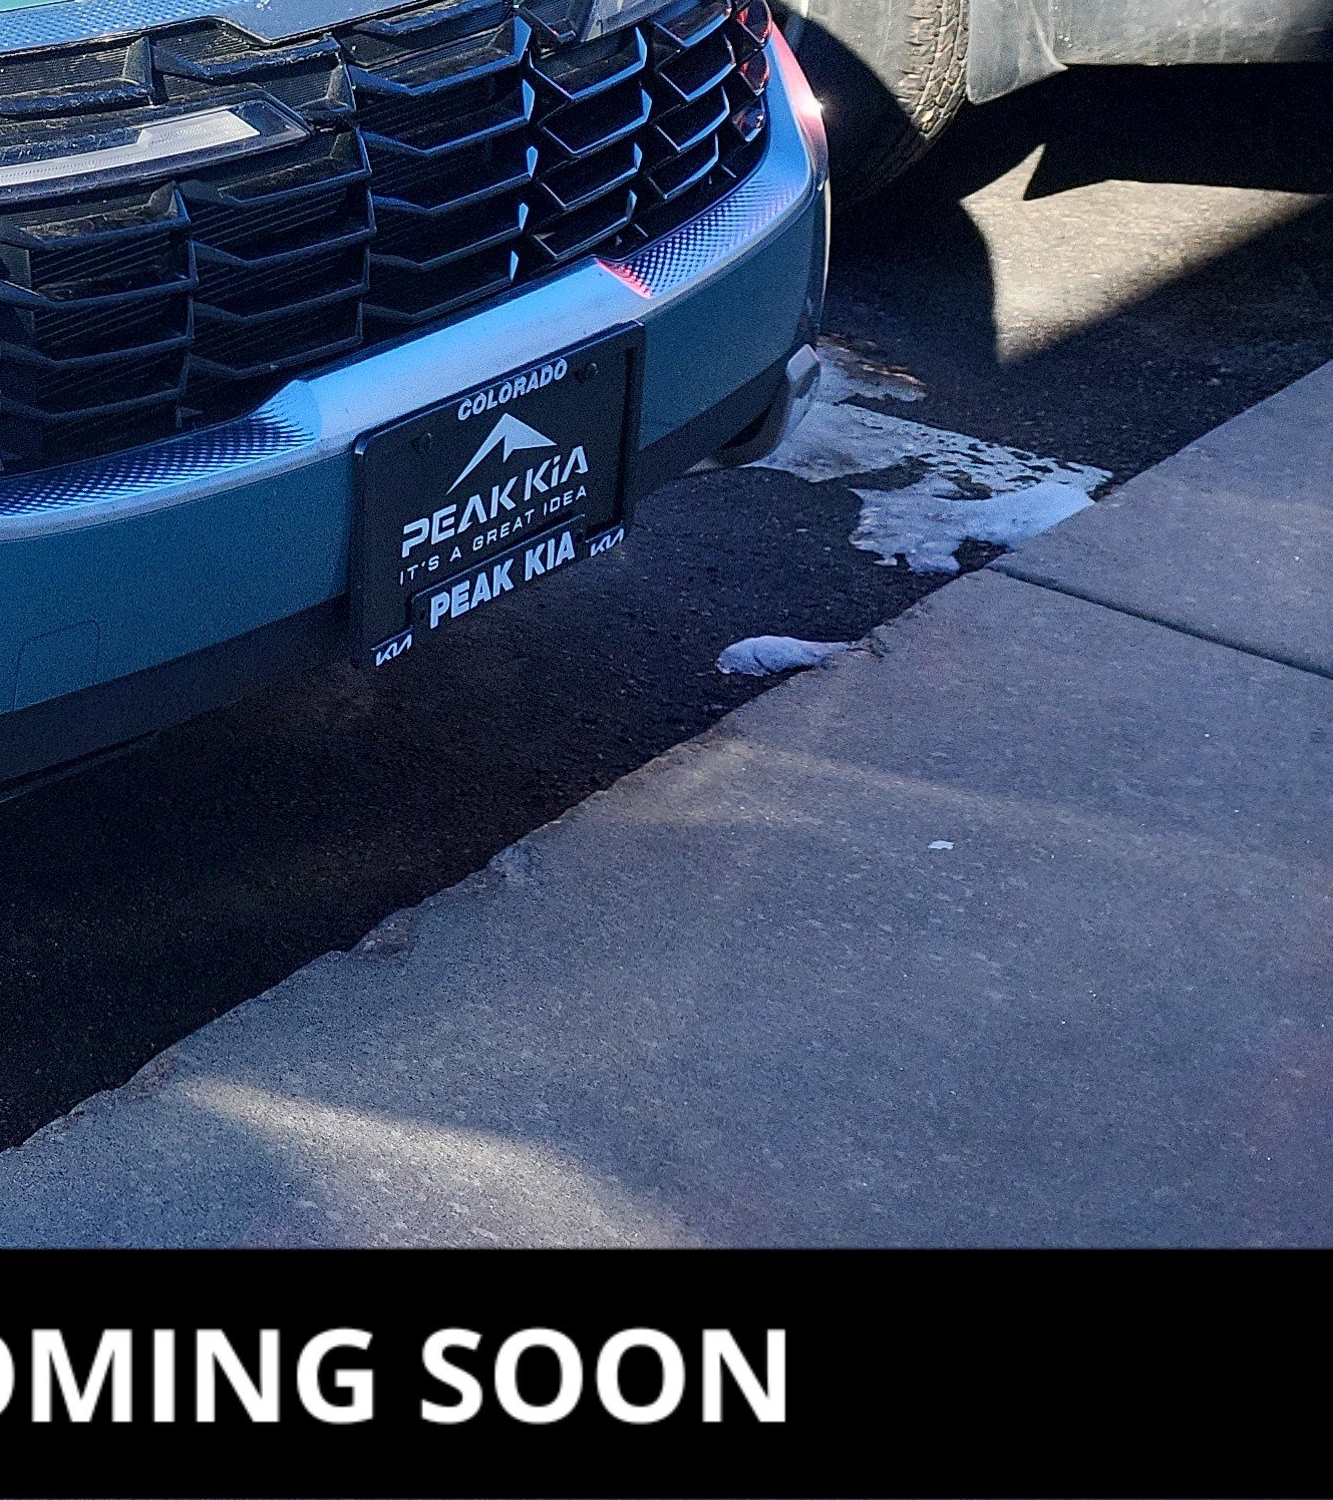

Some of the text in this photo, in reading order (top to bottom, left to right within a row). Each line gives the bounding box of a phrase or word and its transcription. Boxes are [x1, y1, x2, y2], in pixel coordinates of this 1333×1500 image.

[458, 358, 567, 421] COLORADO
[399, 485, 588, 585] IT'S A GREAT IDEA
[401, 476, 517, 558] PEAK
[429, 531, 575, 629] PEAK KIA
